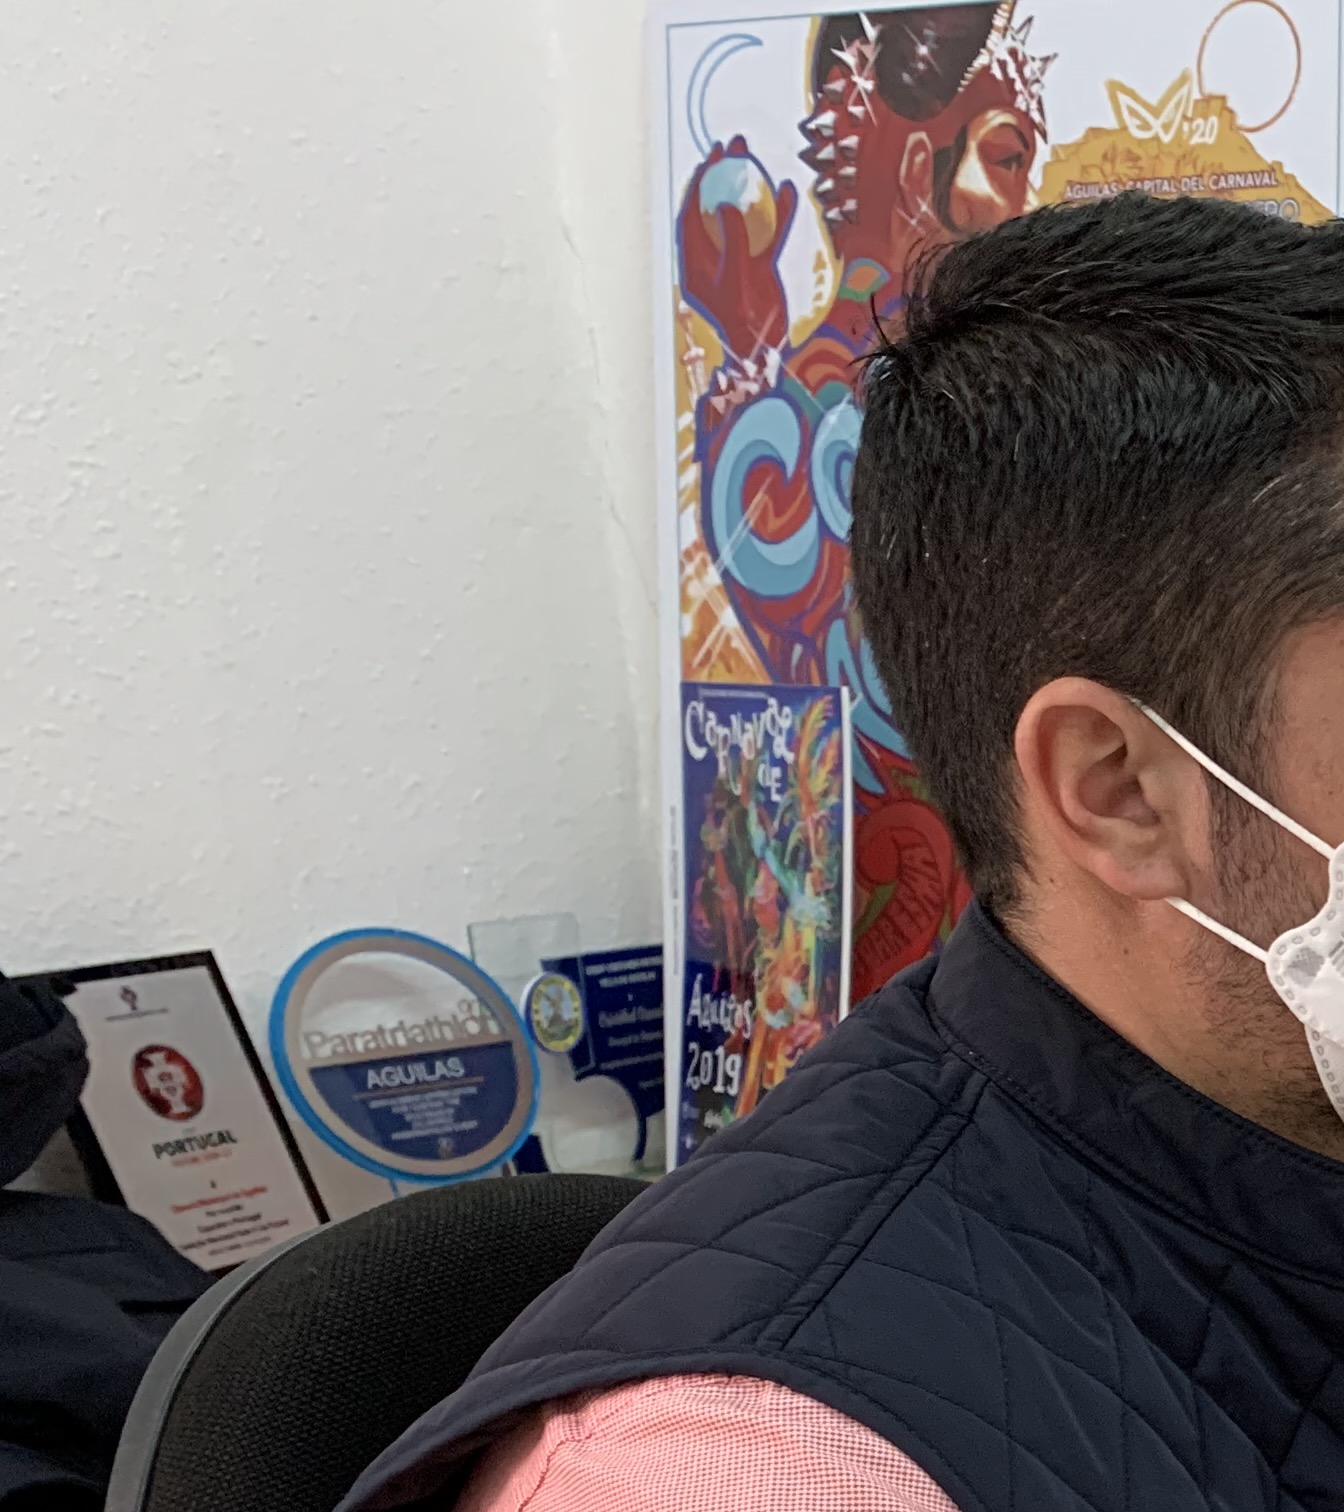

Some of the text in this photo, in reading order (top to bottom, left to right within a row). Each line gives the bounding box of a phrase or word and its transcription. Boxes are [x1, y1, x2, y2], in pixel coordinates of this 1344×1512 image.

[1181, 175, 1205, 191] DEL
[1208, 170, 1278, 190] CARNAVAL
[686, 1041, 742, 1097] 2019
[152, 1130, 239, 1160] PORTUGAL
